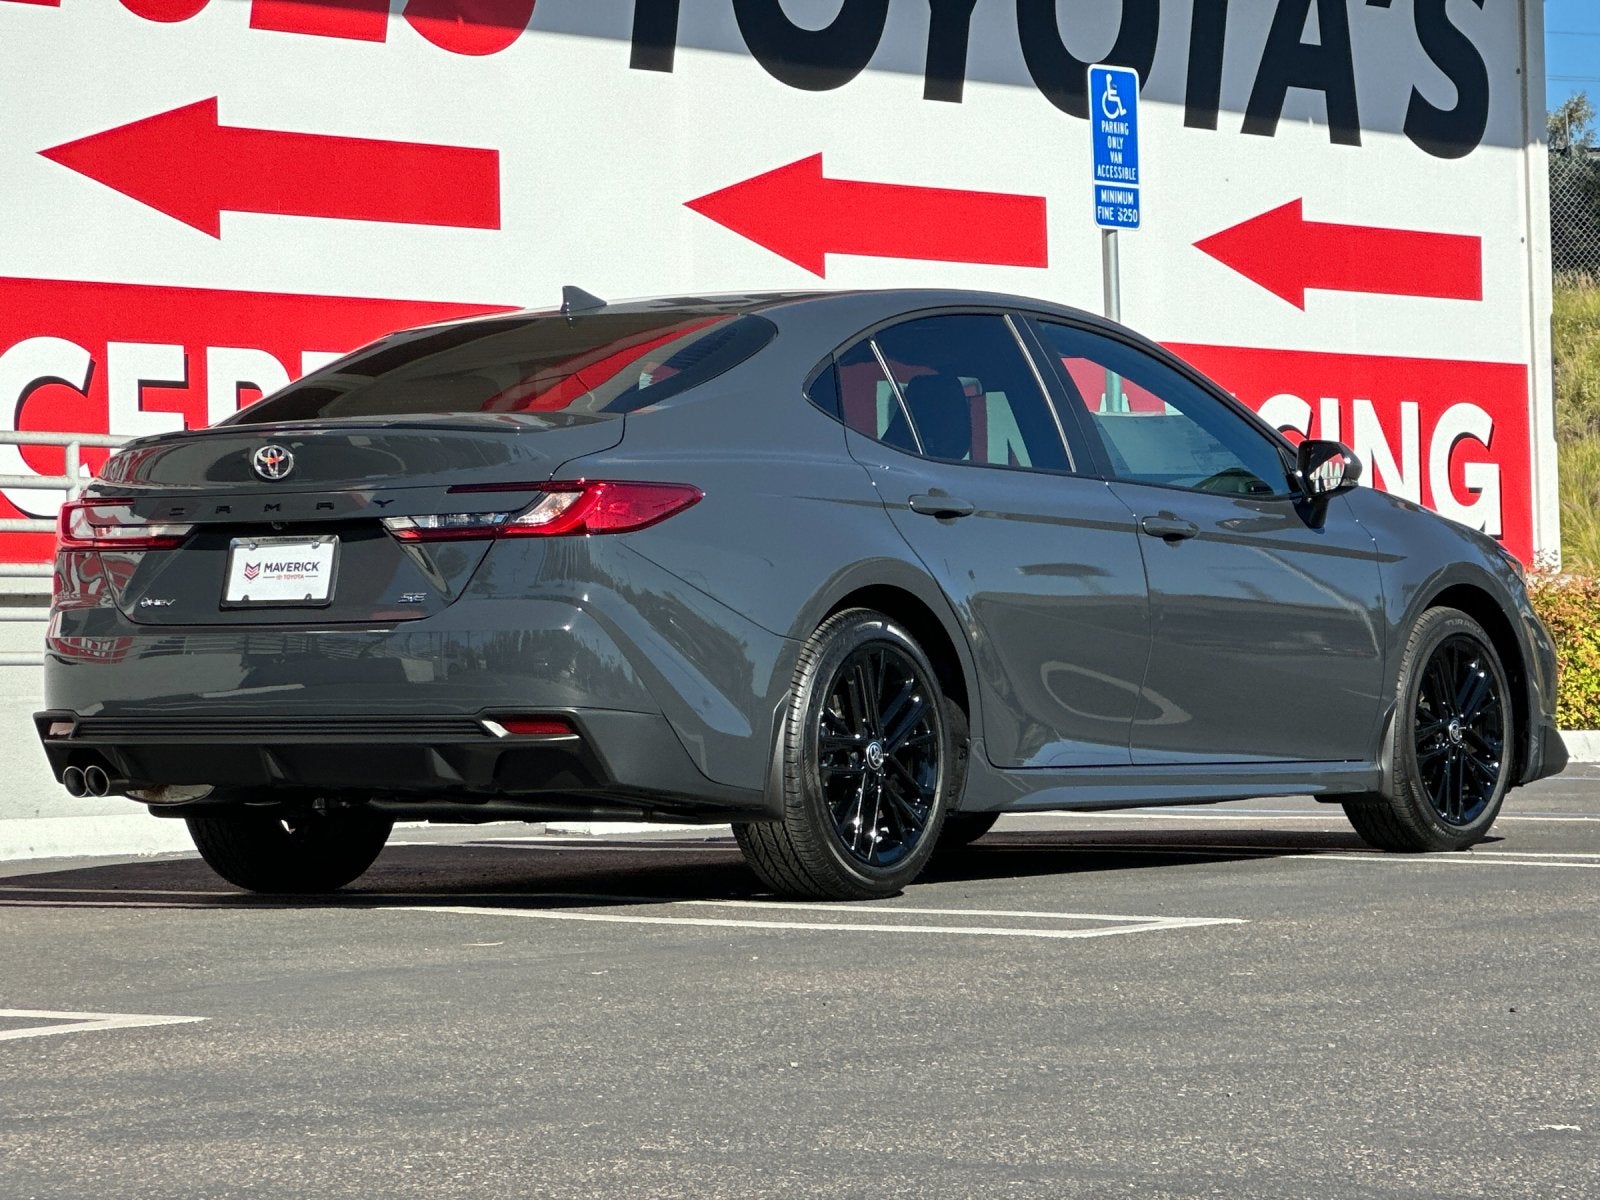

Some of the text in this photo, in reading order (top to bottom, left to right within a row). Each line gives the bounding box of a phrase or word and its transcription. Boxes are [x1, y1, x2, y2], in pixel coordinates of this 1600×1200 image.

[1101, 120, 1129, 135] PARKING
[1107, 136, 1124, 150] ONLY
[1110, 151, 1123, 165] VAN
[1097, 165, 1136, 181] ACCESSIBLE
[1101, 189, 1134, 205] MINIMUM
[1098, 205, 1138, 223] FINE $250
[263, 561, 320, 573] MAVERICK
